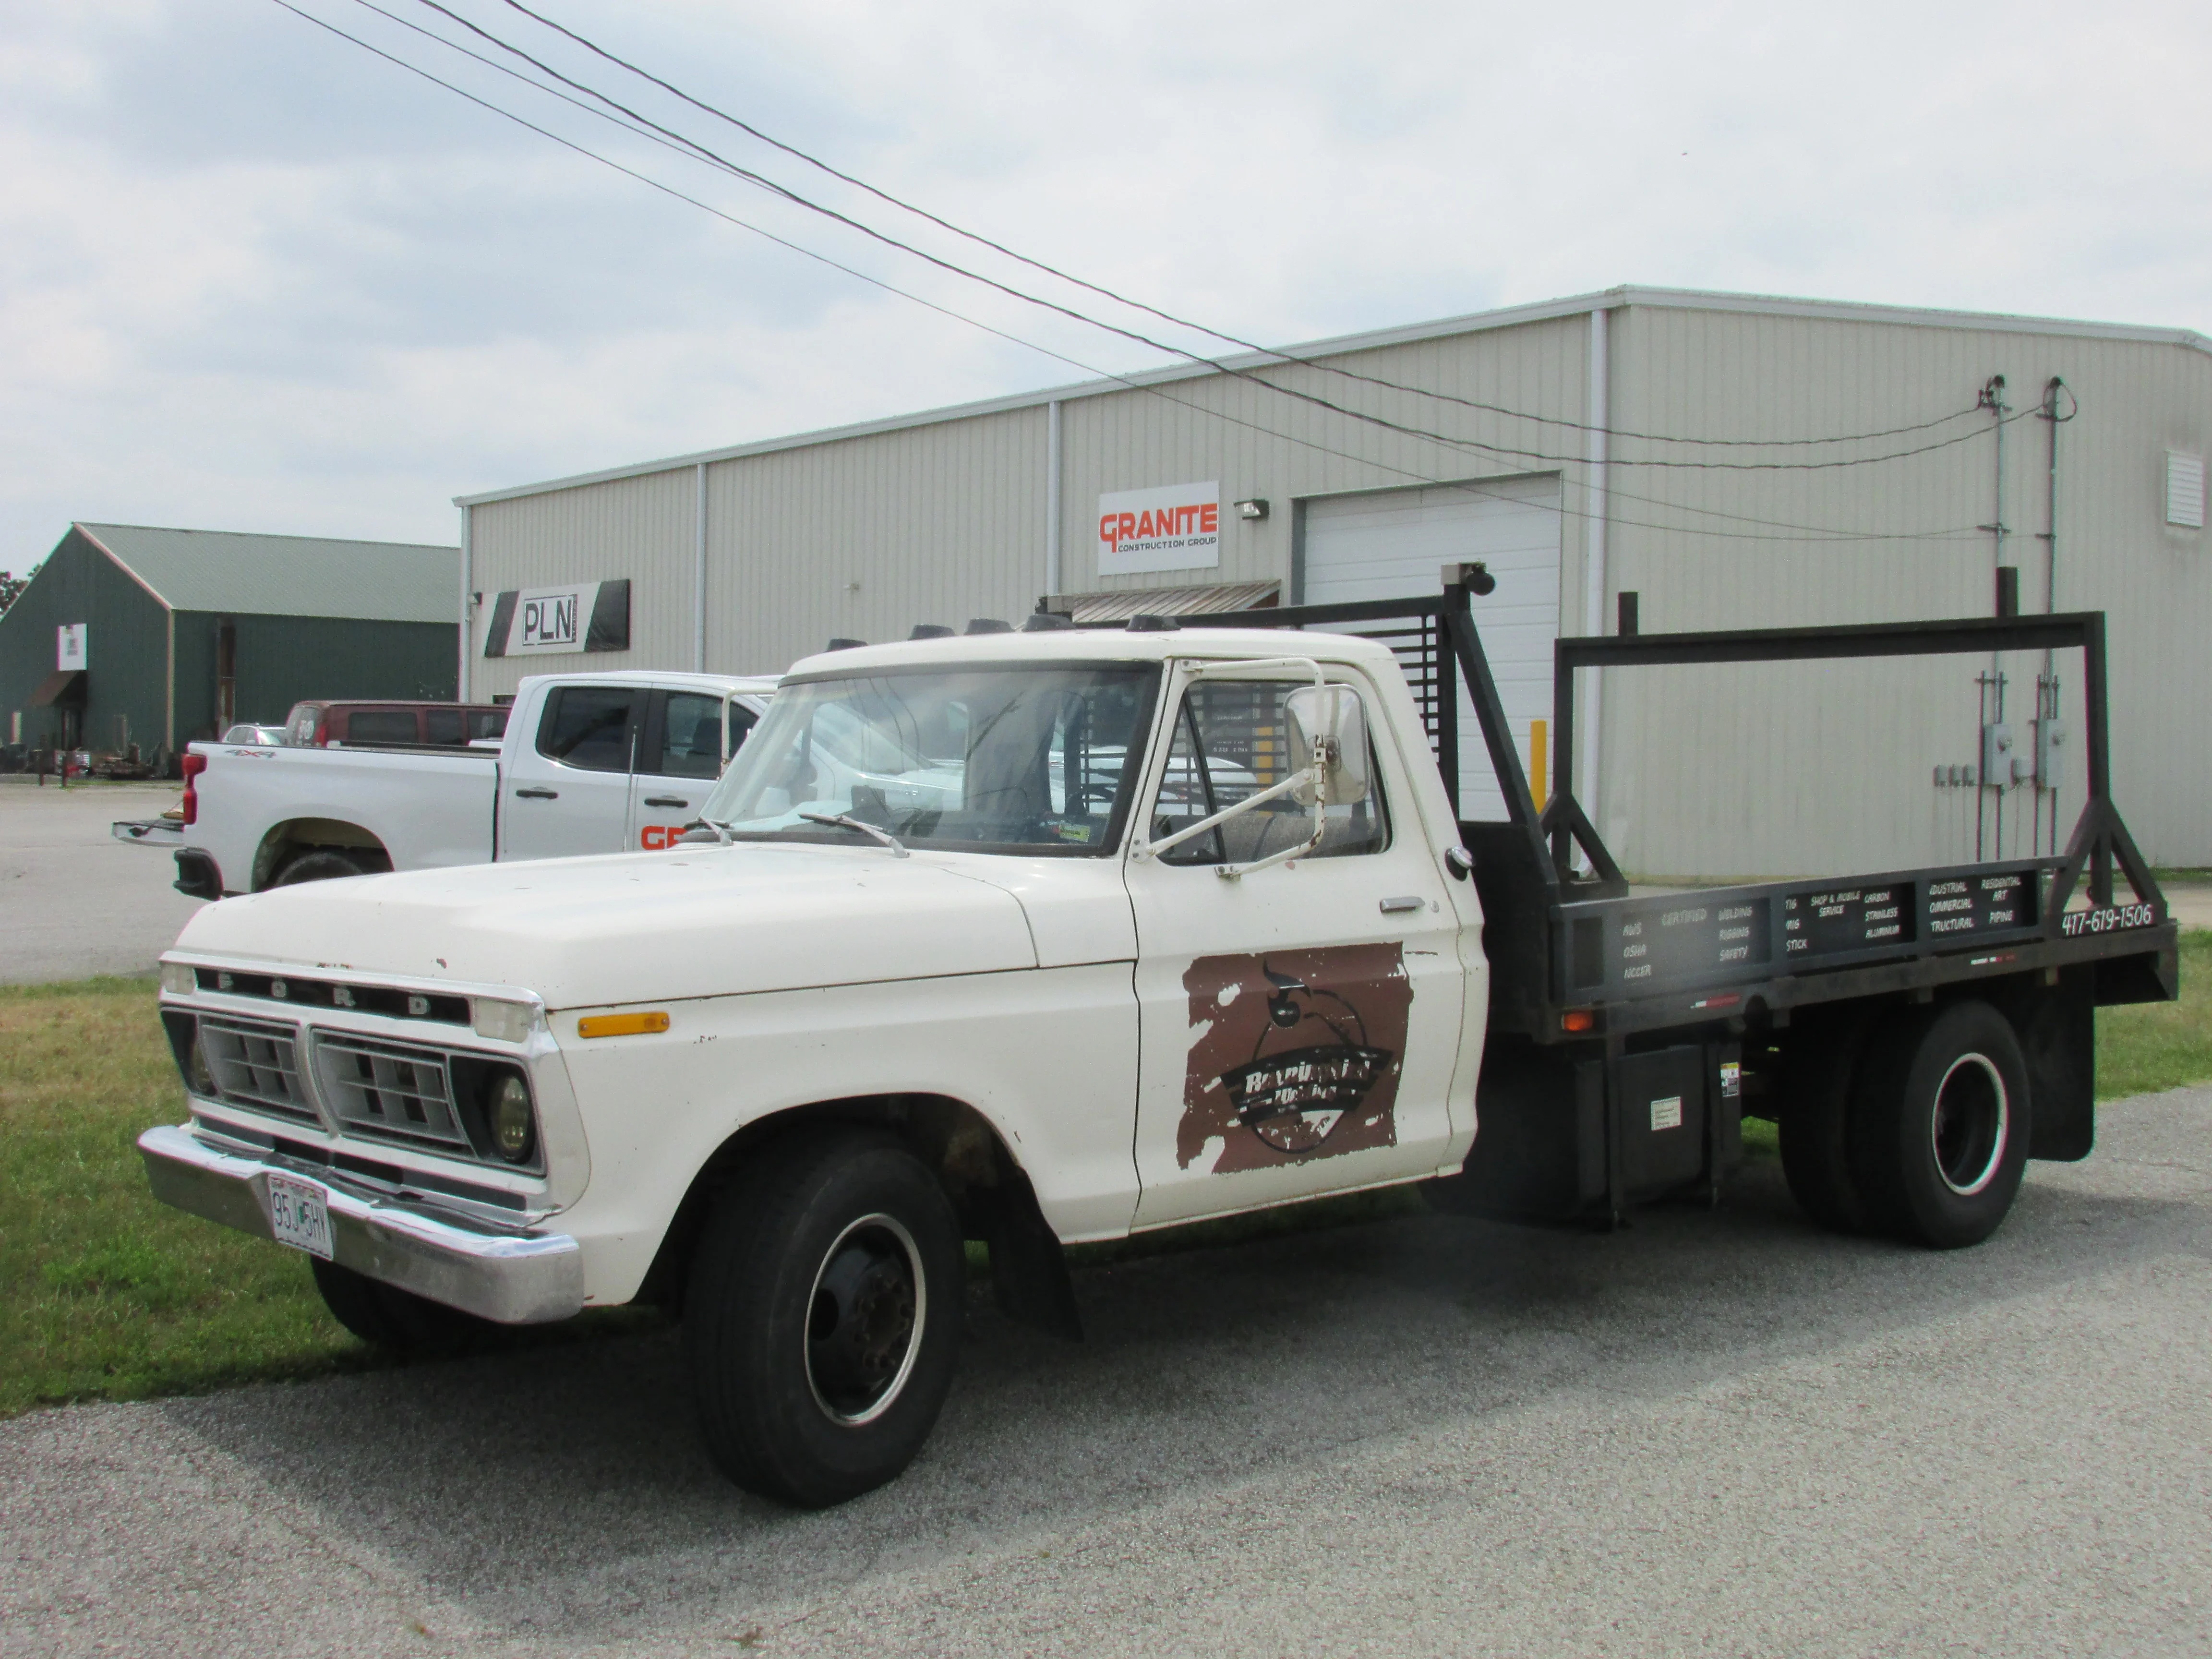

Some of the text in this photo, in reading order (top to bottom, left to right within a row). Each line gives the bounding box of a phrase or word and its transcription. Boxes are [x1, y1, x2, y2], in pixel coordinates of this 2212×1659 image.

[1099, 503, 1218, 553] GRANITE
[1118, 537, 1217, 552] CONSTRUCTION GROUP
[525, 599, 571, 641] PLN
[1929, 882, 1967, 895] DUSTRIAL
[1993, 890, 2008, 901] ART
[1785, 899, 1797, 910] TIG
[1811, 890, 1861, 906] SHOP & MOBILE
[1864, 891, 1890, 903] CARBON
[1819, 904, 1844, 917] SERVICE
[1929, 898, 1972, 913] OMMERCIAL
[1719, 906, 1752, 921] WELDING
[1865, 907, 1899, 922] STAINLESS
[2062, 904, 2152, 936] 417-619-1506
[1865, 925, 1900, 938] ALUMINUM
[1930, 917, 1974, 932] TRUCTURAL
[1623, 944, 1647, 958] OSHA
[1786, 938, 1808, 951] STICK
[1719, 946, 1748, 961] SAFETY
[1624, 964, 1651, 980] NCCER
[217, 971, 431, 1015] FORD
